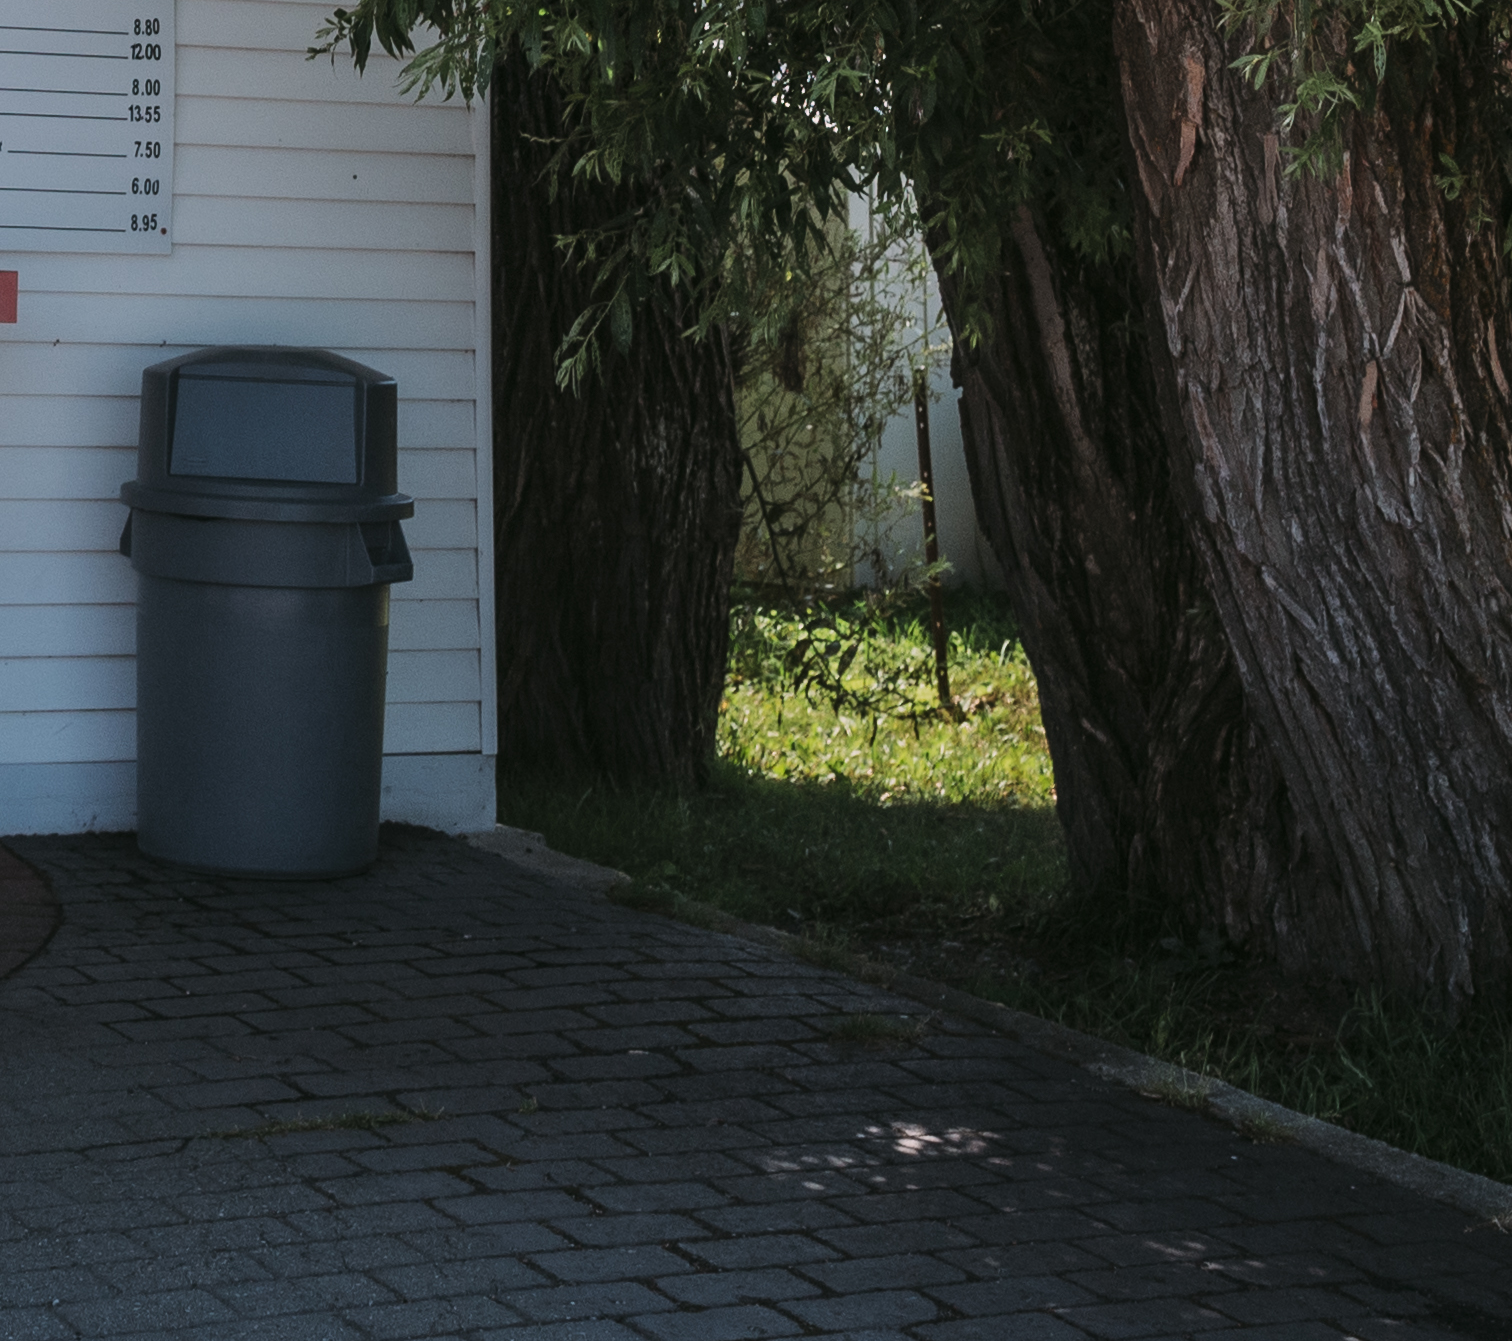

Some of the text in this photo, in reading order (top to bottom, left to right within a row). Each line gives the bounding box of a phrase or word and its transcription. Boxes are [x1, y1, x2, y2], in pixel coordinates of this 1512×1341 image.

[134, 18, 160, 36] 8.80
[132, 79, 160, 96] 8.00
[135, 141, 160, 158] 7.50
[132, 178, 159, 195] 6.00
